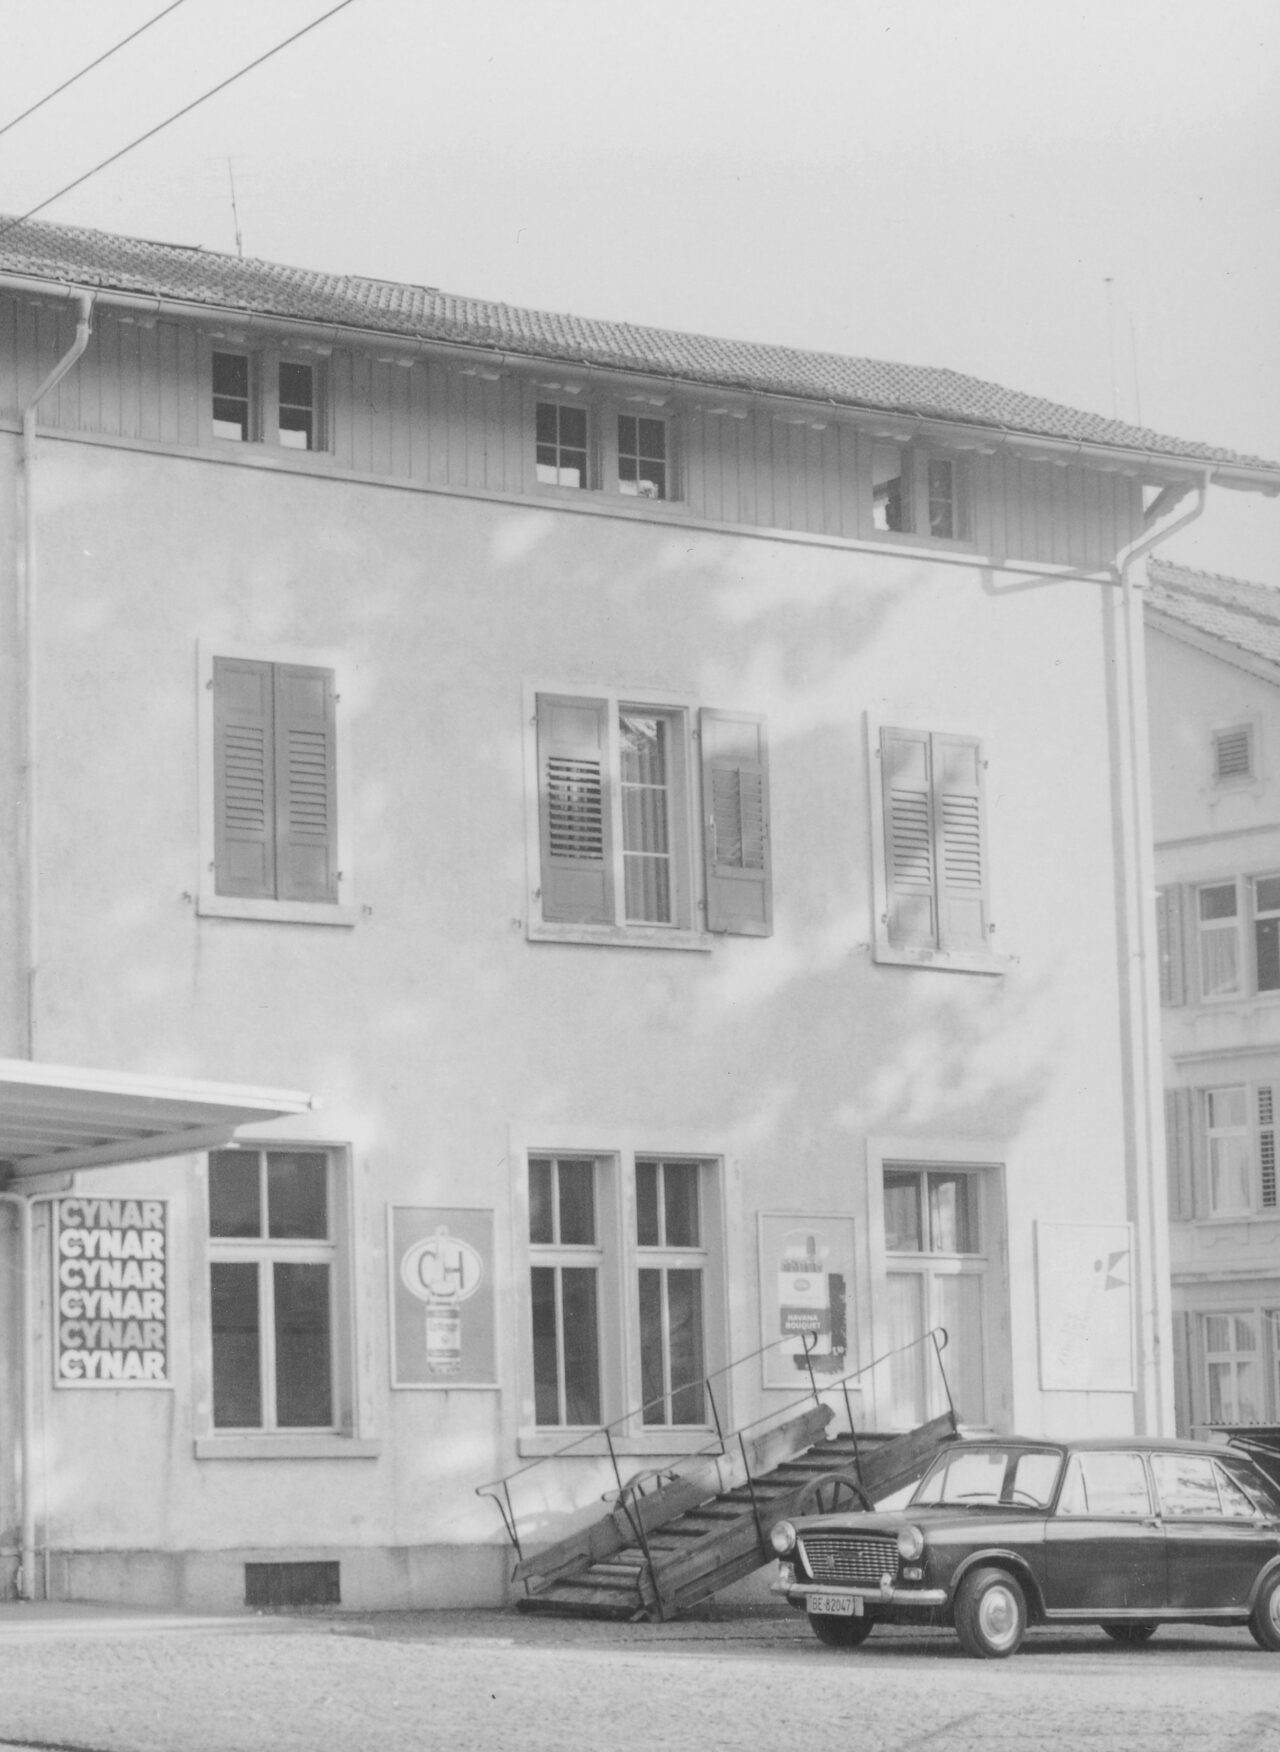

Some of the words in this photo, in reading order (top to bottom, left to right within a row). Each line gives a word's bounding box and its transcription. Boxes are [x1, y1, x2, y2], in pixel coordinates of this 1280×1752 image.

[60, 1199, 164, 1229] CYNAR
[59, 1228, 165, 1260] CYNAR
[60, 1259, 165, 1290] CYNAR
[418, 1251, 464, 1289] CH
[60, 1289, 165, 1320] CYNAR
[60, 1319, 165, 1350] CYNAR
[785, 1321, 822, 1330] BOUQUET
[60, 1349, 166, 1380] CYNAR
